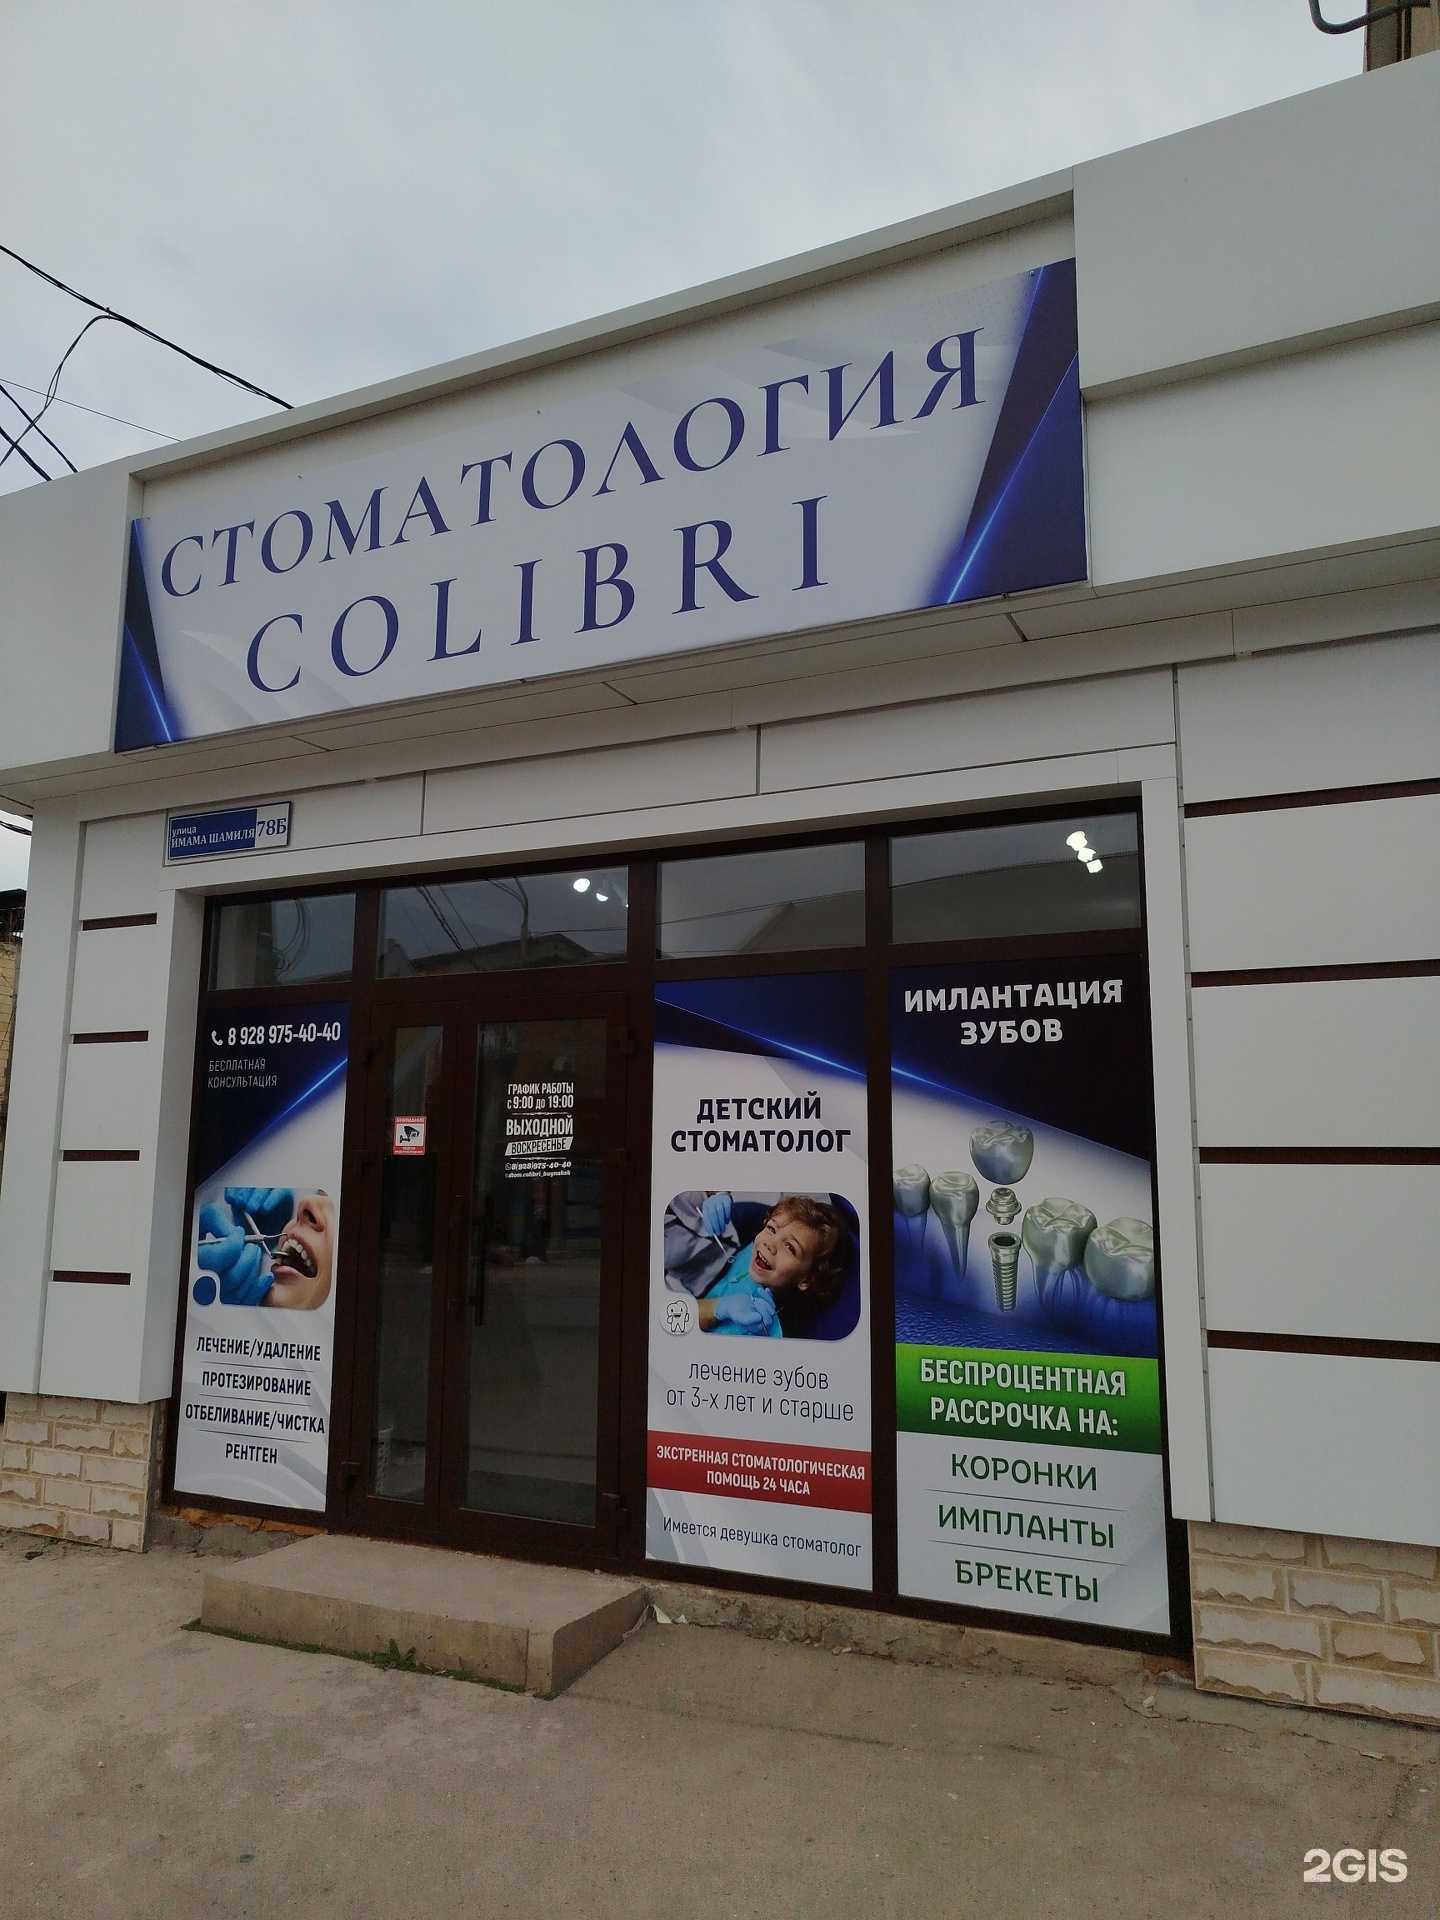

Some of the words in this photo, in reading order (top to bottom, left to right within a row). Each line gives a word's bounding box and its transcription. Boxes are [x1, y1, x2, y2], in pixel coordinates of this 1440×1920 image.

[160, 327, 987, 598] СТОМАТОЛОГИЯ
[246, 494, 829, 693] COLIBRI
[171, 825, 197, 838] улица
[171, 834, 207, 848] ИМАМА
[209, 828, 255, 843] ШАМИЛЯ
[257, 818, 287, 837] 78Б
[904, 979, 1123, 1013] ИМЛАНТАЦИЯ
[228, 1027, 236, 1046] 8
[240, 1026, 264, 1045] 928
[268, 1022, 341, 1044] 975-40-40
[960, 1018, 1064, 1045] ЗУБОВ
[209, 1058, 266, 1072] БЕСПЛАТНАЯ
[208, 1075, 277, 1088] КОНСУЛЬТАЦИЯ
[508, 1083, 540, 1095] ГРАФИК
[541, 1082, 574, 1094] РАБОТЫ
[513, 1096, 534, 1109] 9:00
[548, 1094, 574, 1108] 19:00
[696, 1090, 821, 1124] ДЕТСКИЙ
[506, 1114, 574, 1137] ВЫХОДНОЙ
[511, 1138, 567, 1154] ВОСКРЕСЕНЬЕ
[671, 1129, 851, 1153] СТОМАТОЛОГ
[196, 1336, 321, 1361] ЛЕЧЕНИЕ/УДАЛЕНИЕ
[202, 1371, 311, 1396] ПРОТЕЗИРОВАНИЕ
[688, 1363, 766, 1385] лечение
[773, 1366, 829, 1392] зубов
[921, 1358, 1126, 1397] БЕСПРОЦЕНТНАЯ
[666, 1388, 686, 1406] от
[691, 1386, 719, 1409] 3-х
[724, 1393, 755, 1413] лет
[762, 1397, 772, 1414] и
[780, 1398, 854, 1423] старше
[930, 1397, 1072, 1432] РАССРОЧКА
[1078, 1408, 1119, 1437] НА:
[185, 1404, 325, 1434] ОТБЕЛИВАНИЕ/ЧИСТКА
[225, 1443, 278, 1464] РЕНТГЕН
[656, 1445, 728, 1466] ЭКСТРЕННАЯ
[731, 1453, 865, 1481] СТОМАТОЛОГИЧЕСКАЯ
[706, 1470, 760, 1490] ПОМОЩЬ
[762, 1476, 778, 1491] 24
[780, 1479, 811, 1495] ЧАСА
[951, 1453, 1098, 1491] КОРОНКИ
[662, 1517, 717, 1538] Имеется
[720, 1527, 778, 1546] девушка
[783, 1535, 862, 1557] стоматолог
[938, 1504, 1114, 1549] ИМПЛАНТЫ
[955, 1559, 1099, 1602] БРЕКЕТЫ
